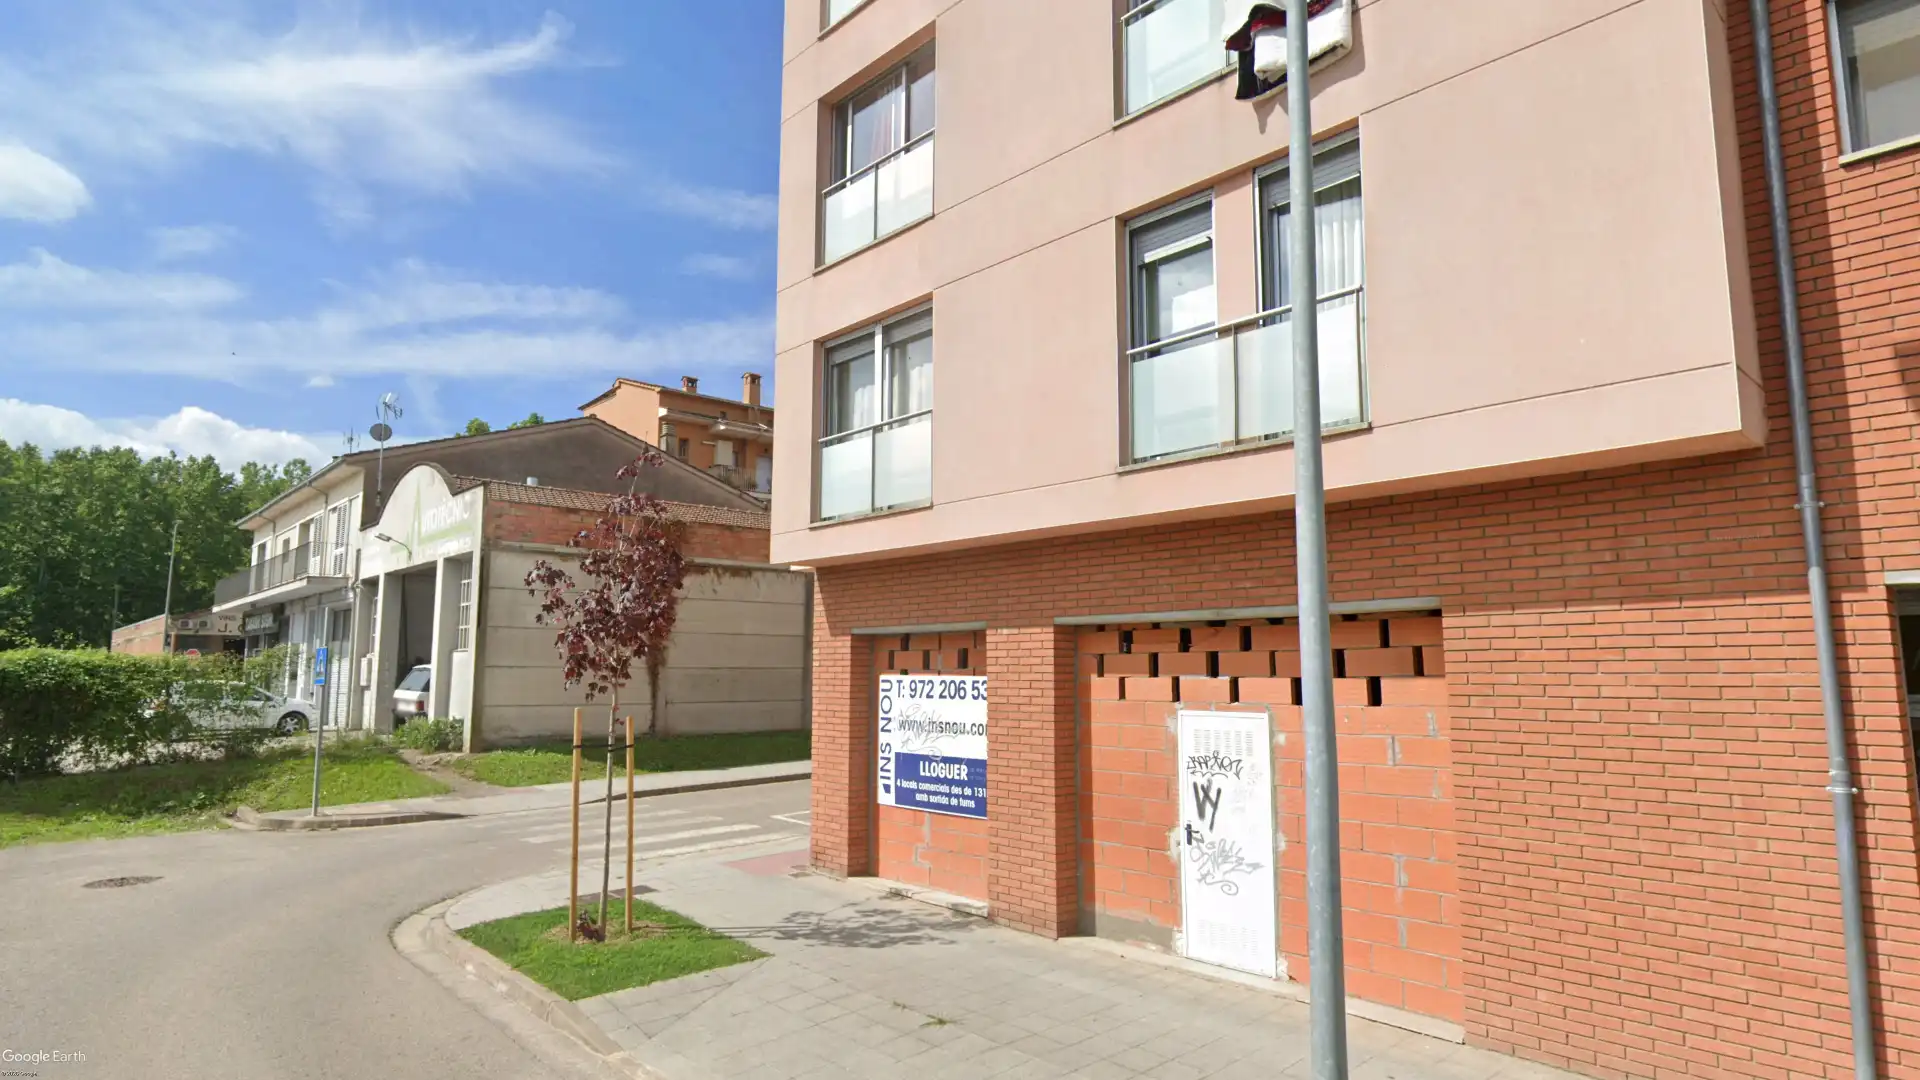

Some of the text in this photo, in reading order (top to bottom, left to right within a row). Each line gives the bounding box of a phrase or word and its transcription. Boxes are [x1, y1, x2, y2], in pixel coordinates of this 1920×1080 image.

[896, 679, 905, 699] T:
[909, 679, 935, 699] 972
[938, 679, 967, 700] 206
[880, 679, 893, 780] INS NOU
[919, 760, 968, 781] LLOGUER
[896, 778, 901, 787] 4
[901, 779, 918, 789] locals
[918, 782, 950, 793] comercials
[950, 785, 962, 795] des
[963, 786, 972, 796] de
[915, 792, 975, 808] amb sortida de fums
